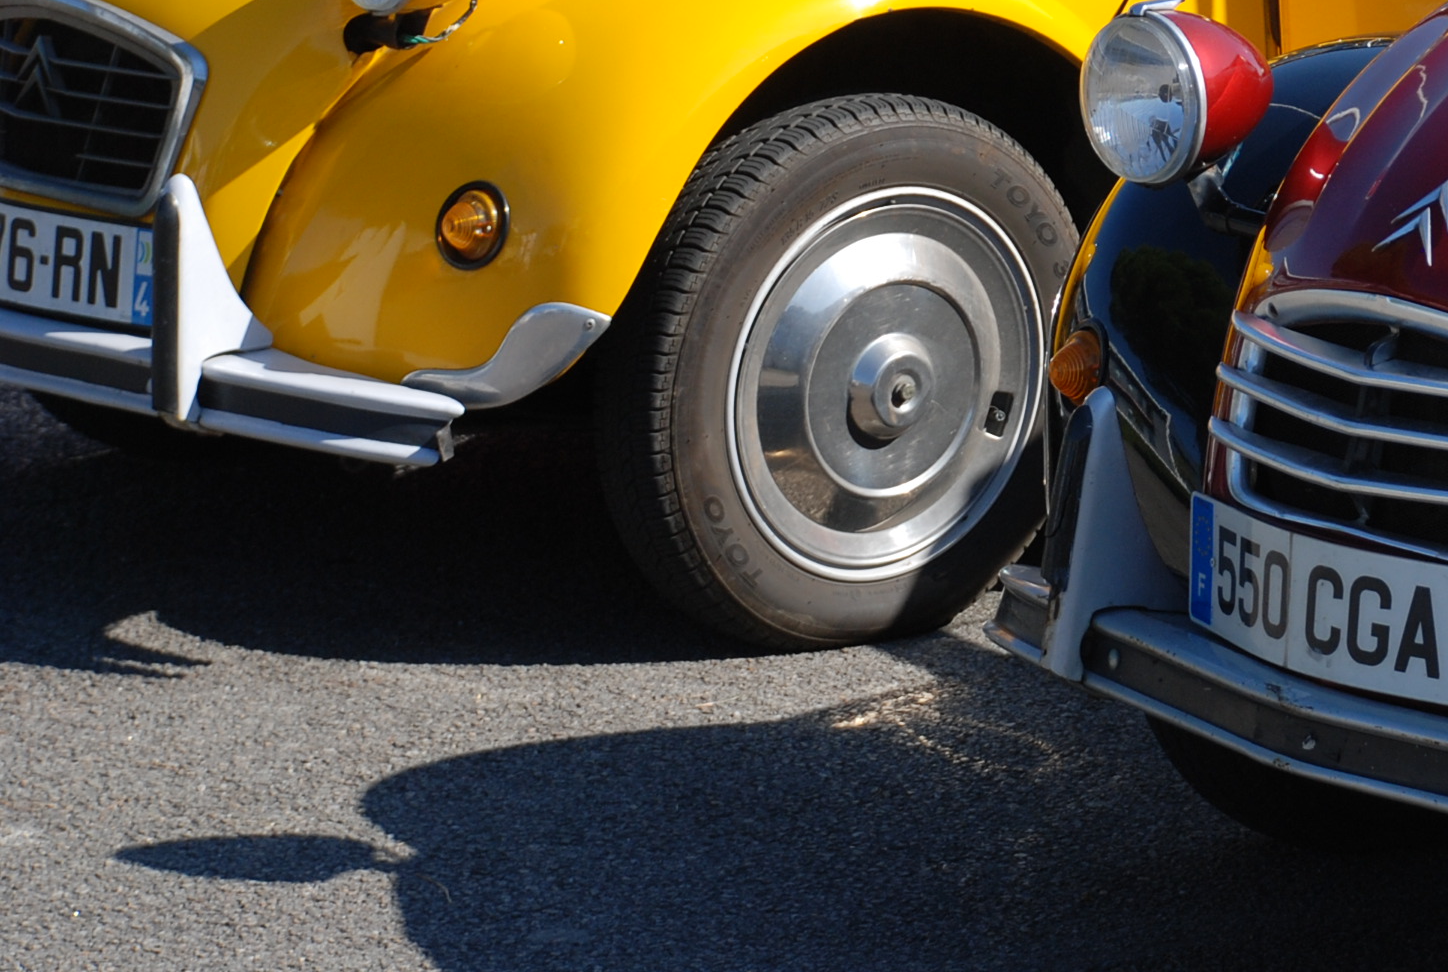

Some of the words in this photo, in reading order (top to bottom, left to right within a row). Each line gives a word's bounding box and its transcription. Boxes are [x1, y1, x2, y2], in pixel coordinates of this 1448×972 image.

[990, 168, 1058, 247] TOYO
[703, 496, 763, 586] TOYO
[1198, 571, 1206, 597] F
[1217, 525, 1291, 640] 550
[1305, 565, 1440, 679] CGA
